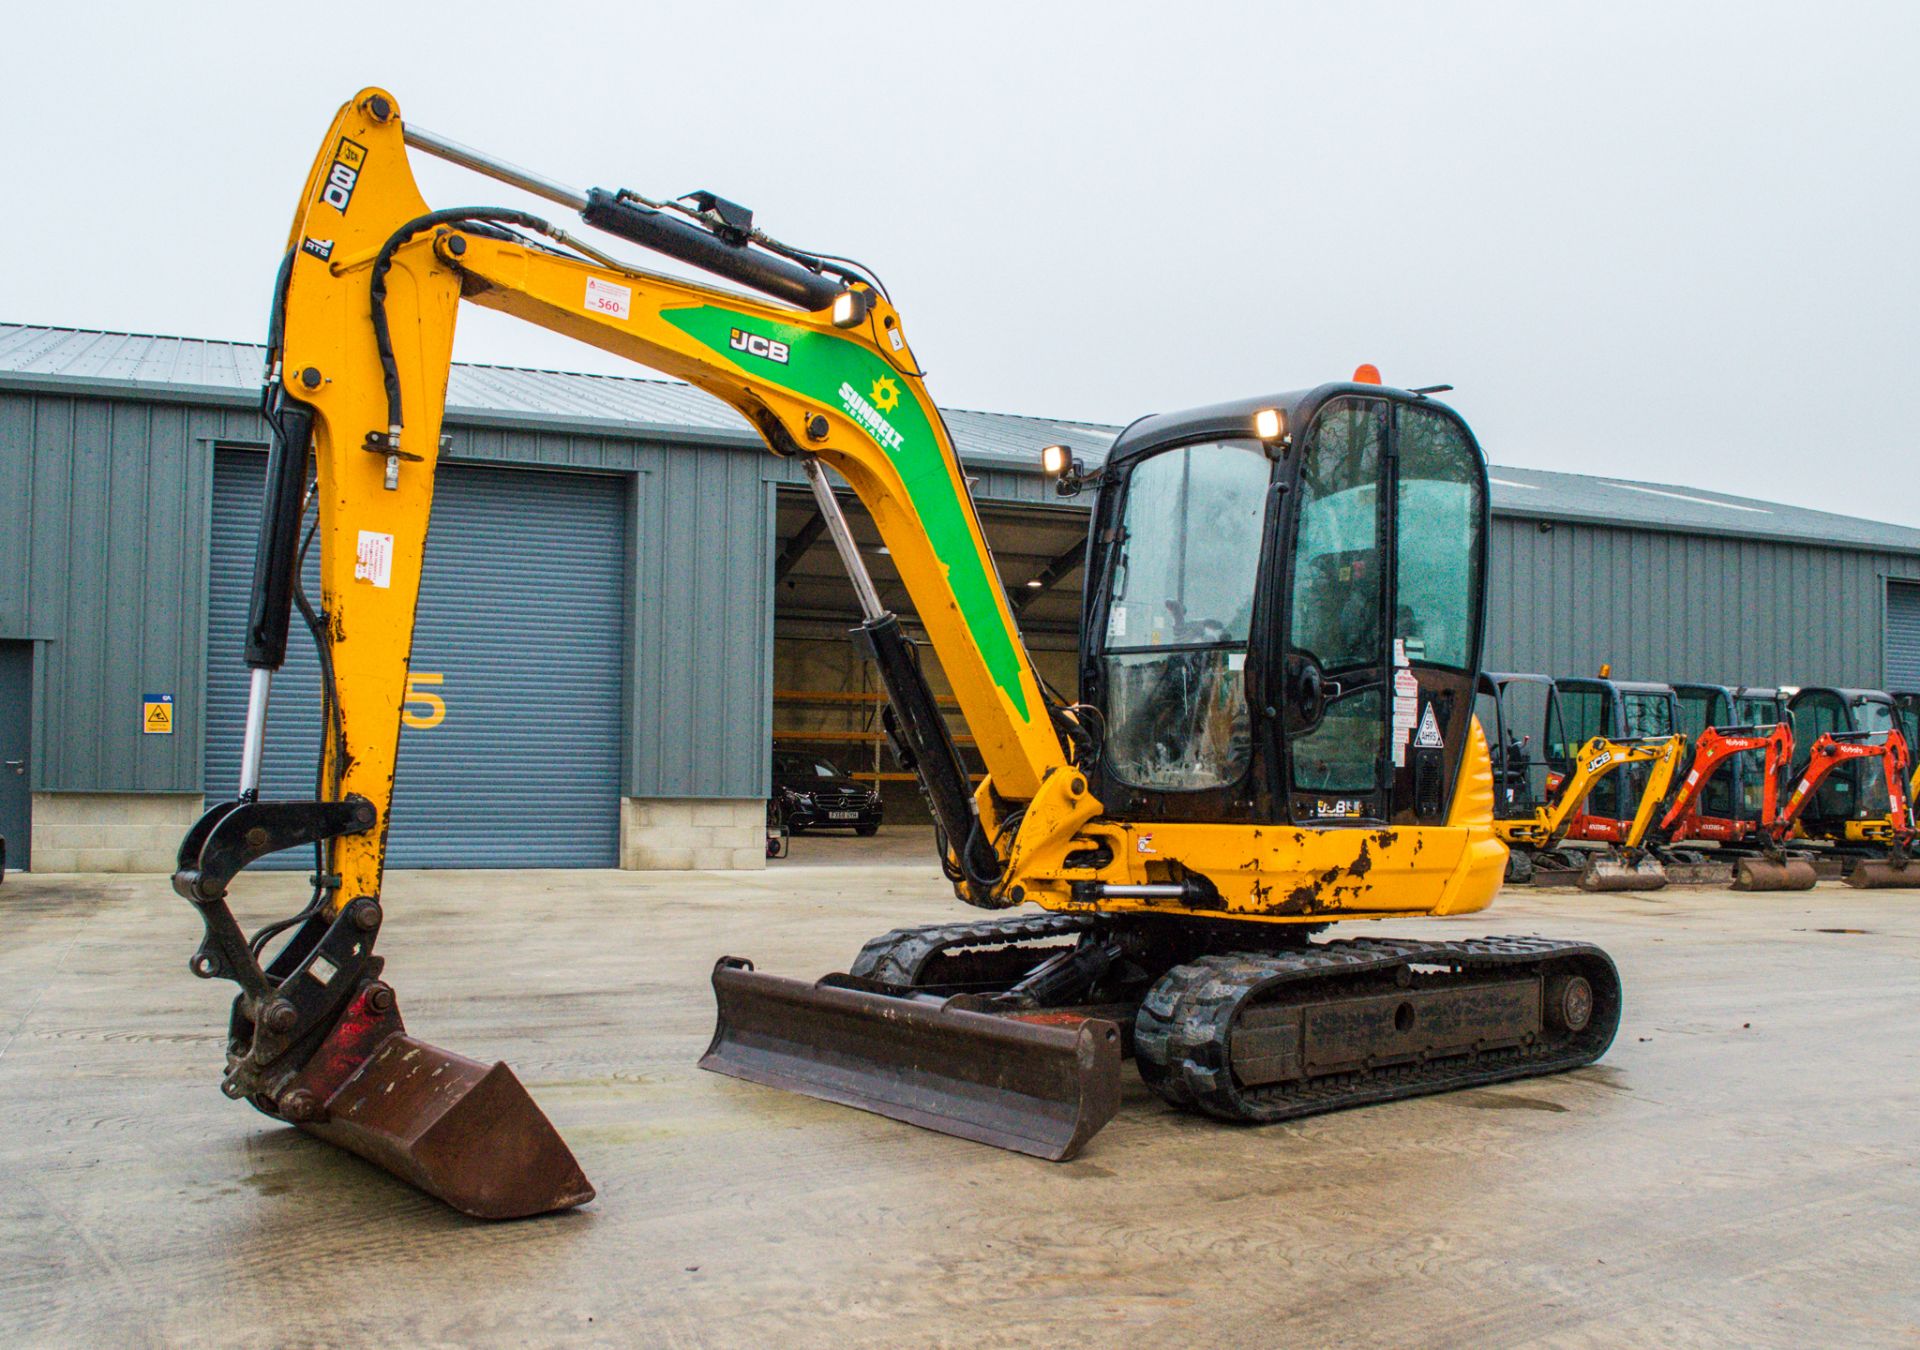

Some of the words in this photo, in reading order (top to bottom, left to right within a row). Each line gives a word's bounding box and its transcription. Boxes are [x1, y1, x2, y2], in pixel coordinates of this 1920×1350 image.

[598, 298, 619, 313] 560
[730, 330, 790, 364] JCB
[838, 382, 904, 451] SUNBELT
[842, 402, 888, 448] RENTALS
[401, 673, 446, 729] 5
[1588, 751, 1611, 773] JCB
[1840, 745, 1864, 754] Kubota
